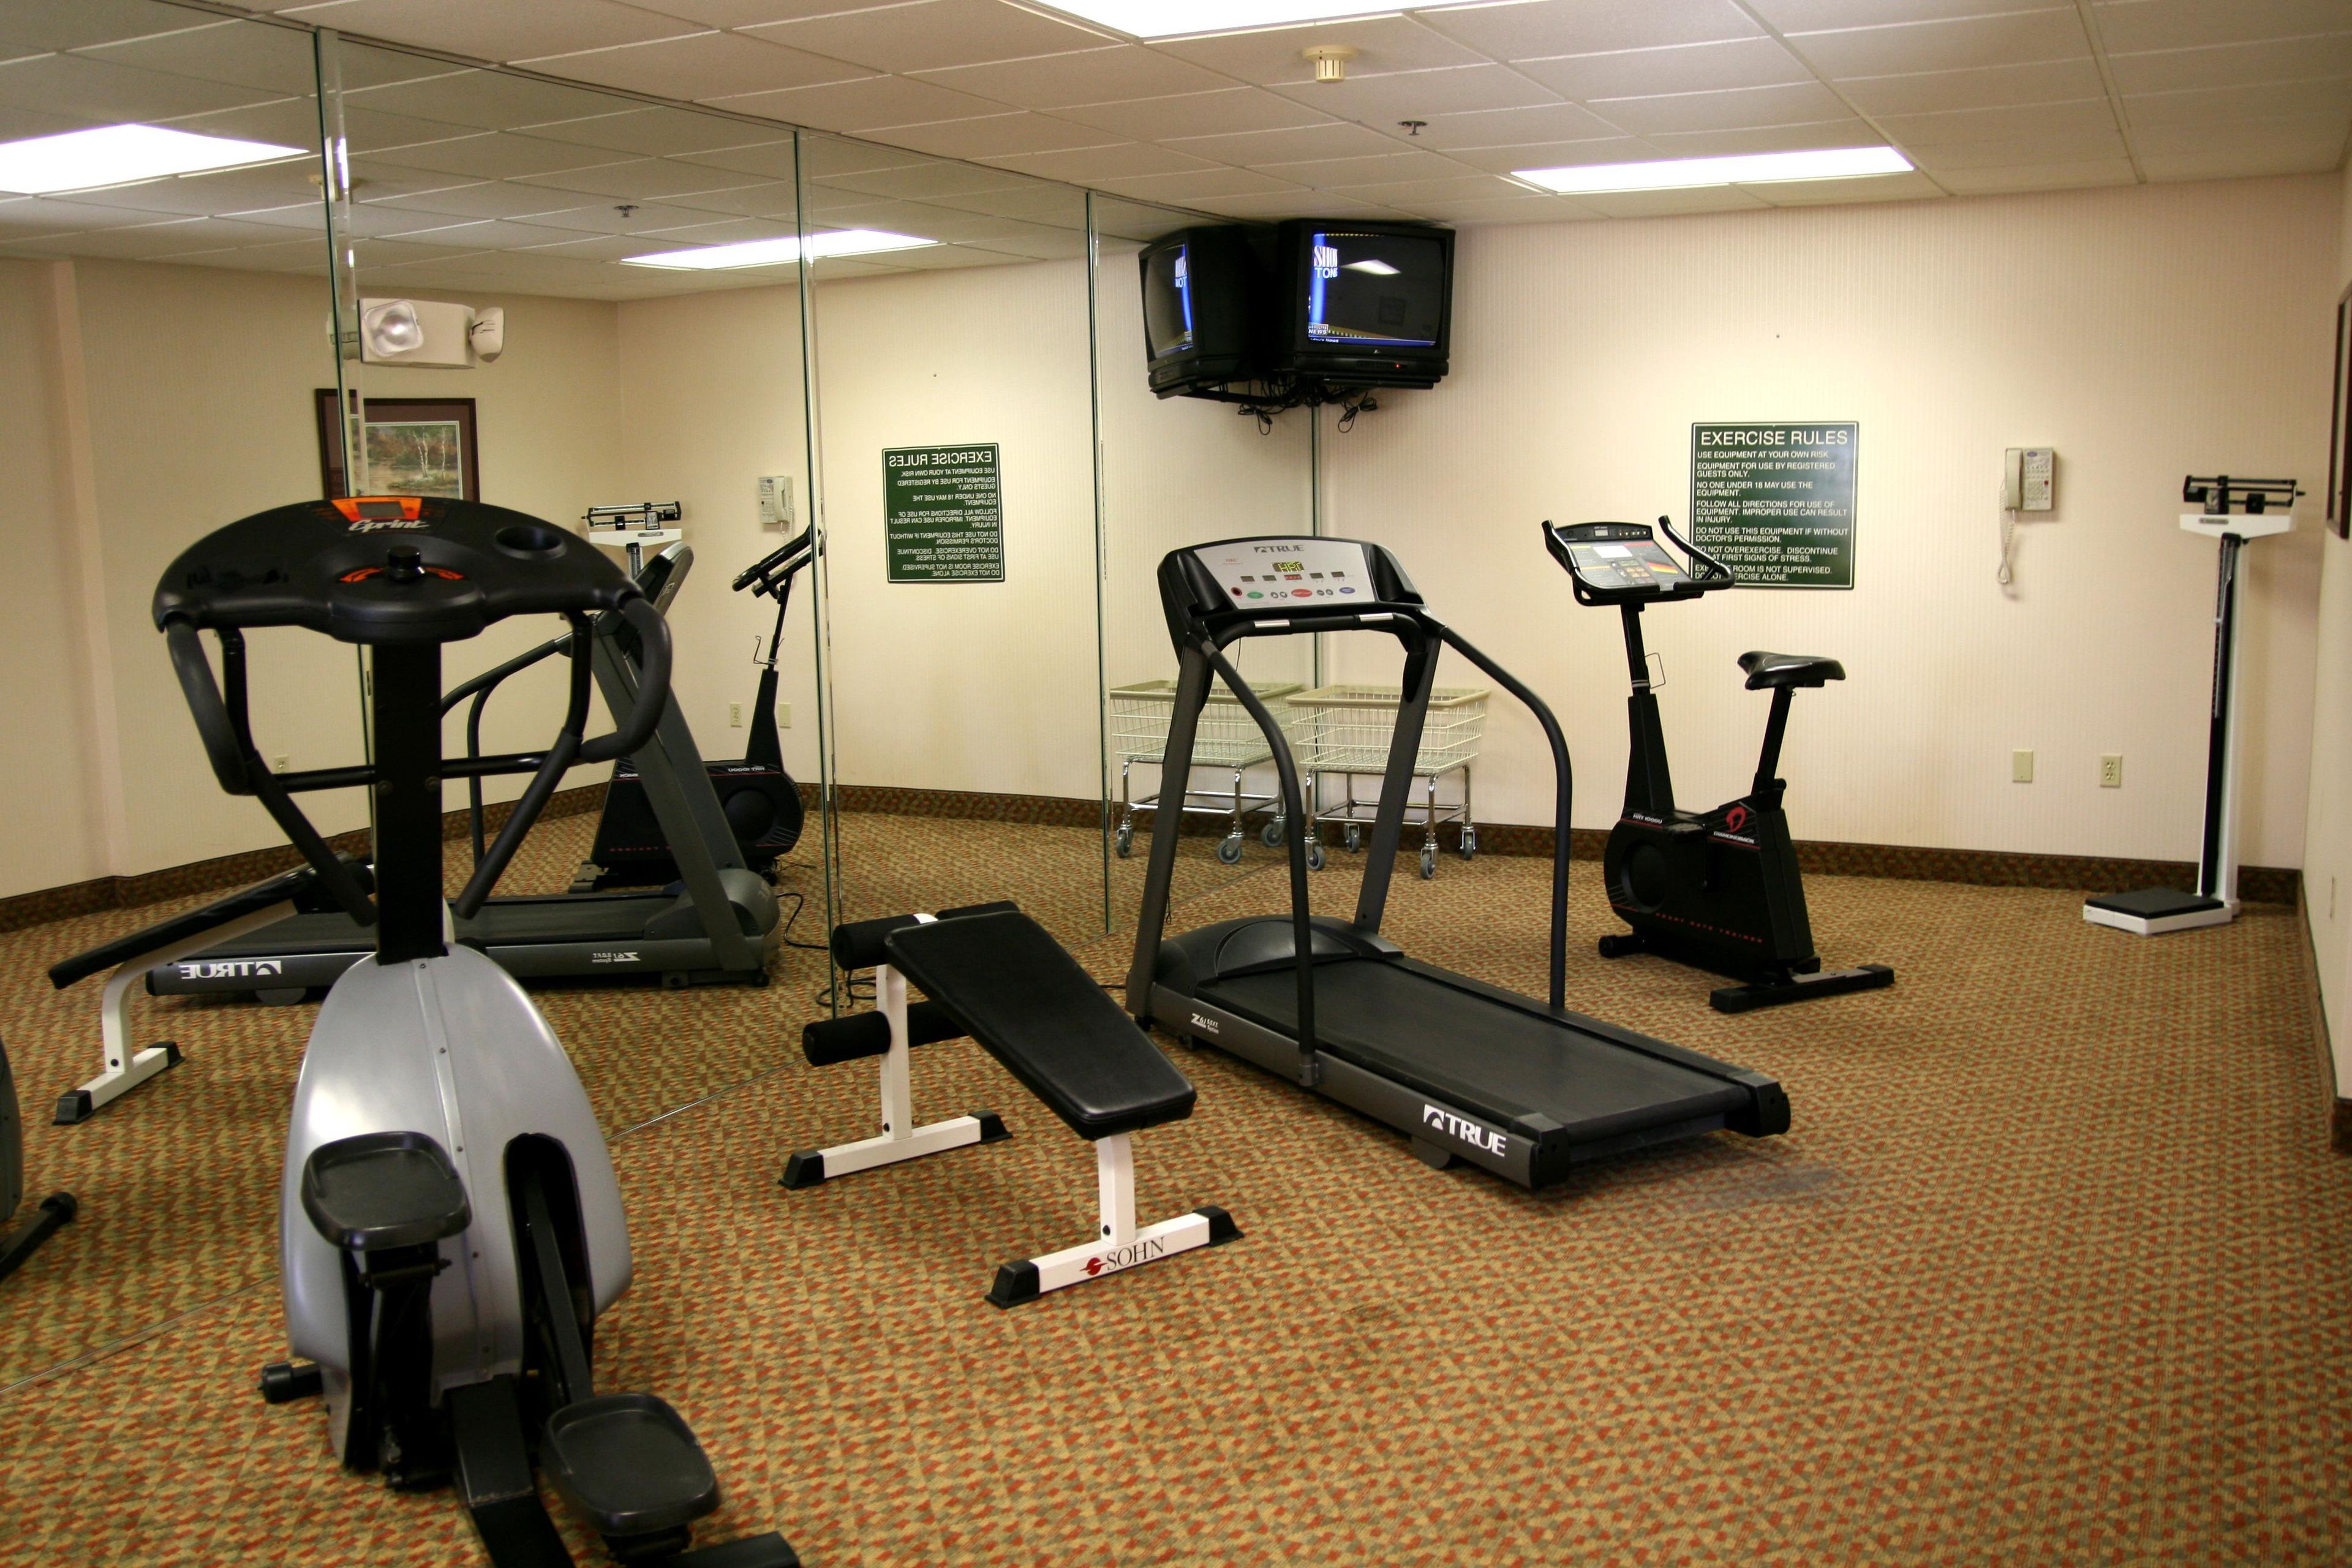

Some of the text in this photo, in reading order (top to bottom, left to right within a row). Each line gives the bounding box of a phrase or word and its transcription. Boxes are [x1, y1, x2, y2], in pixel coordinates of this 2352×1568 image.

[1701, 431, 1848, 445] EXERCISE RULES
[1444, 1112, 1507, 1157] TRUE
[1106, 1237, 1166, 1271] SOHN
